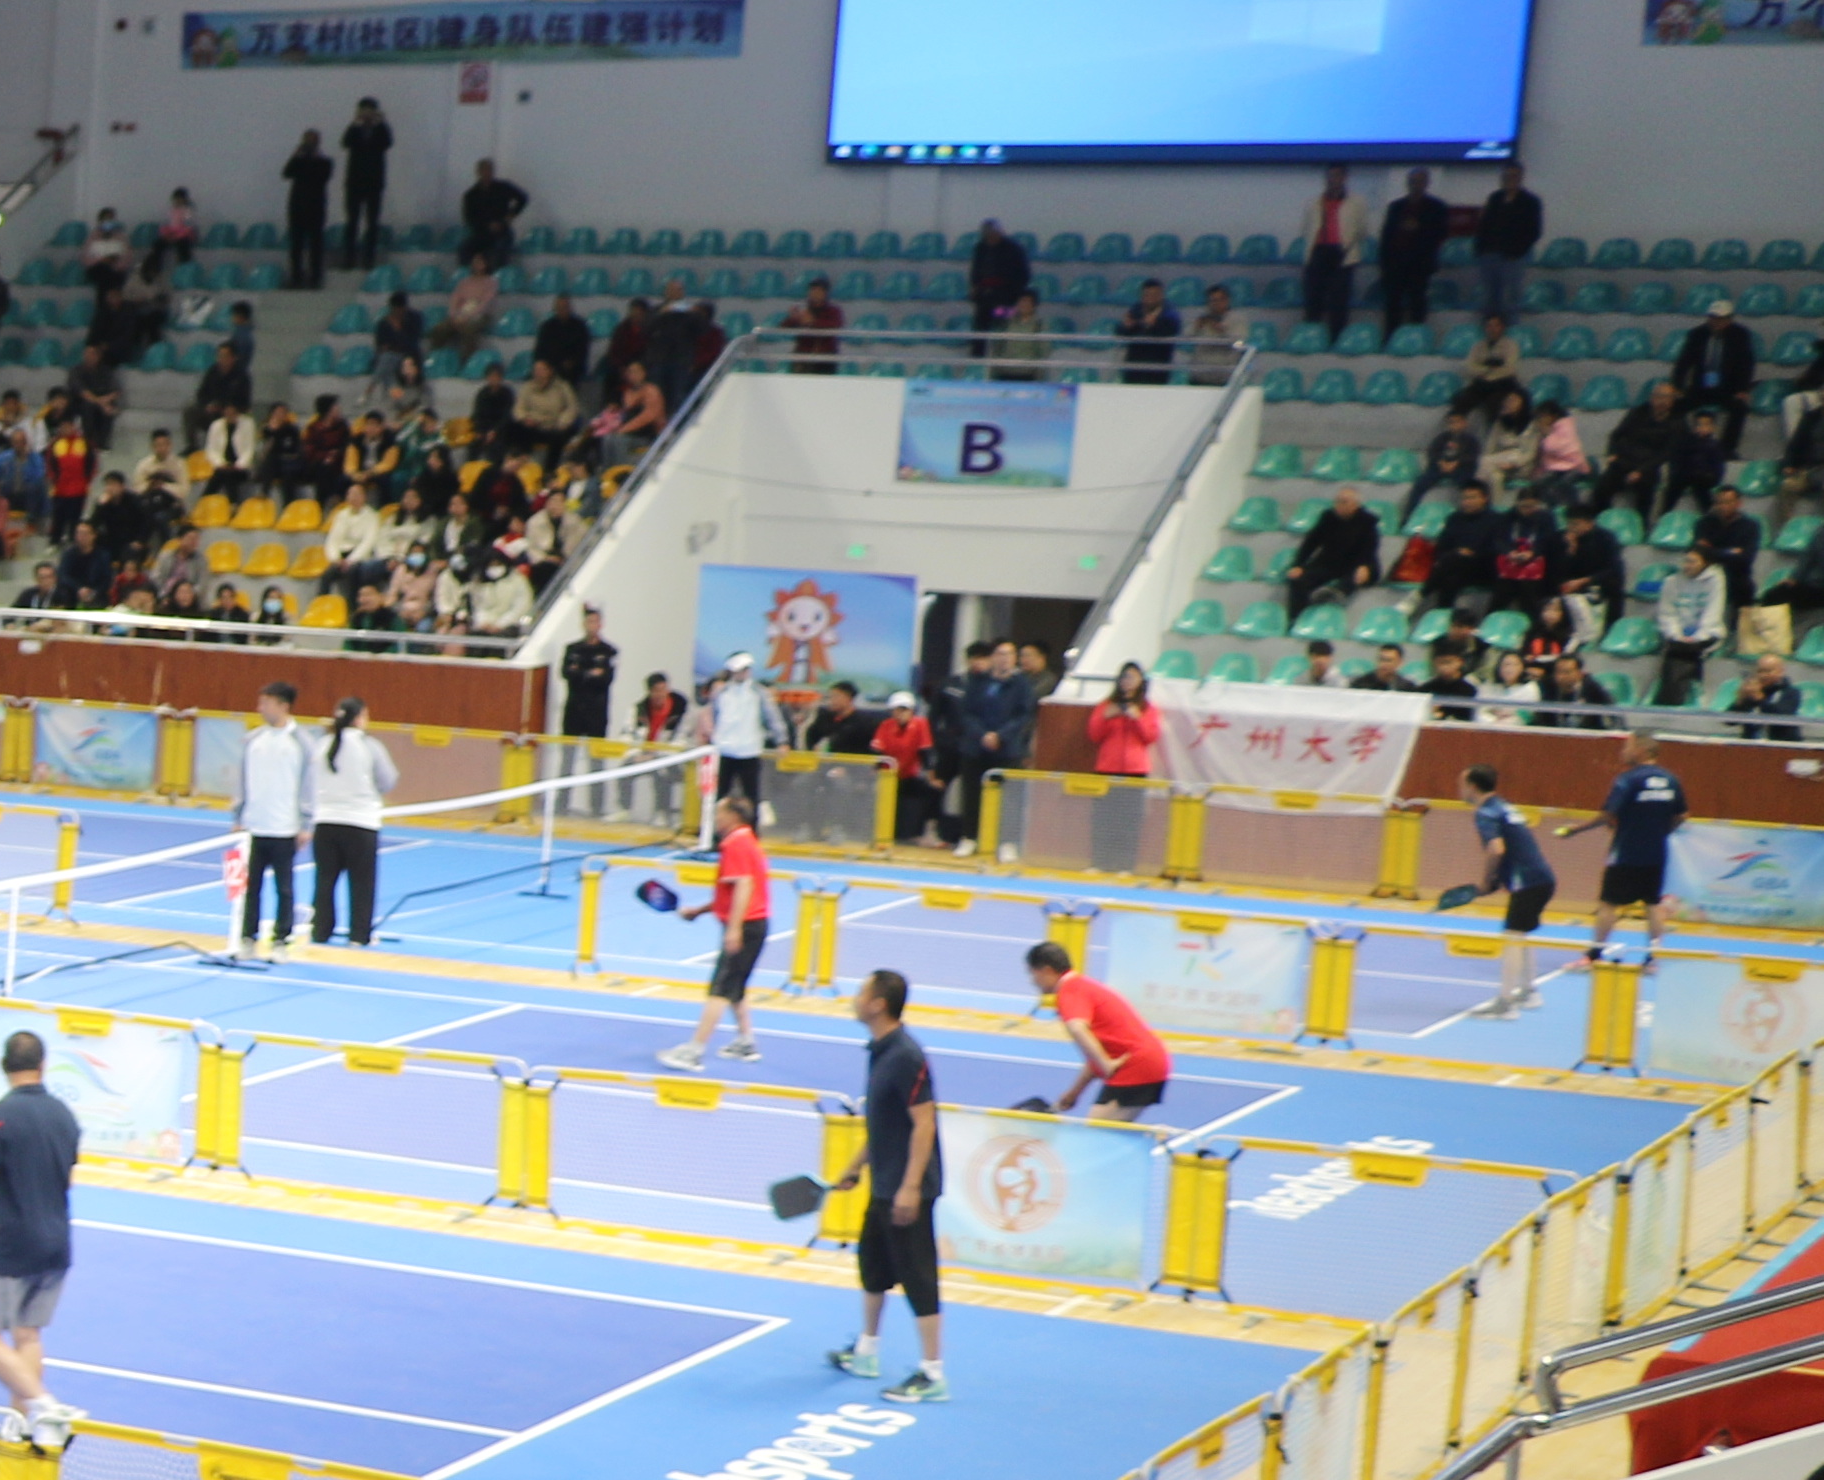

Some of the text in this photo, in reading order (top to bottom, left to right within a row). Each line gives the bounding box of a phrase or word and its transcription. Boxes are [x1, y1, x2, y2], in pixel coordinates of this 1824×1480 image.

[959, 421, 1005, 475] B
[1188, 714, 1386, 764] 广州大学
